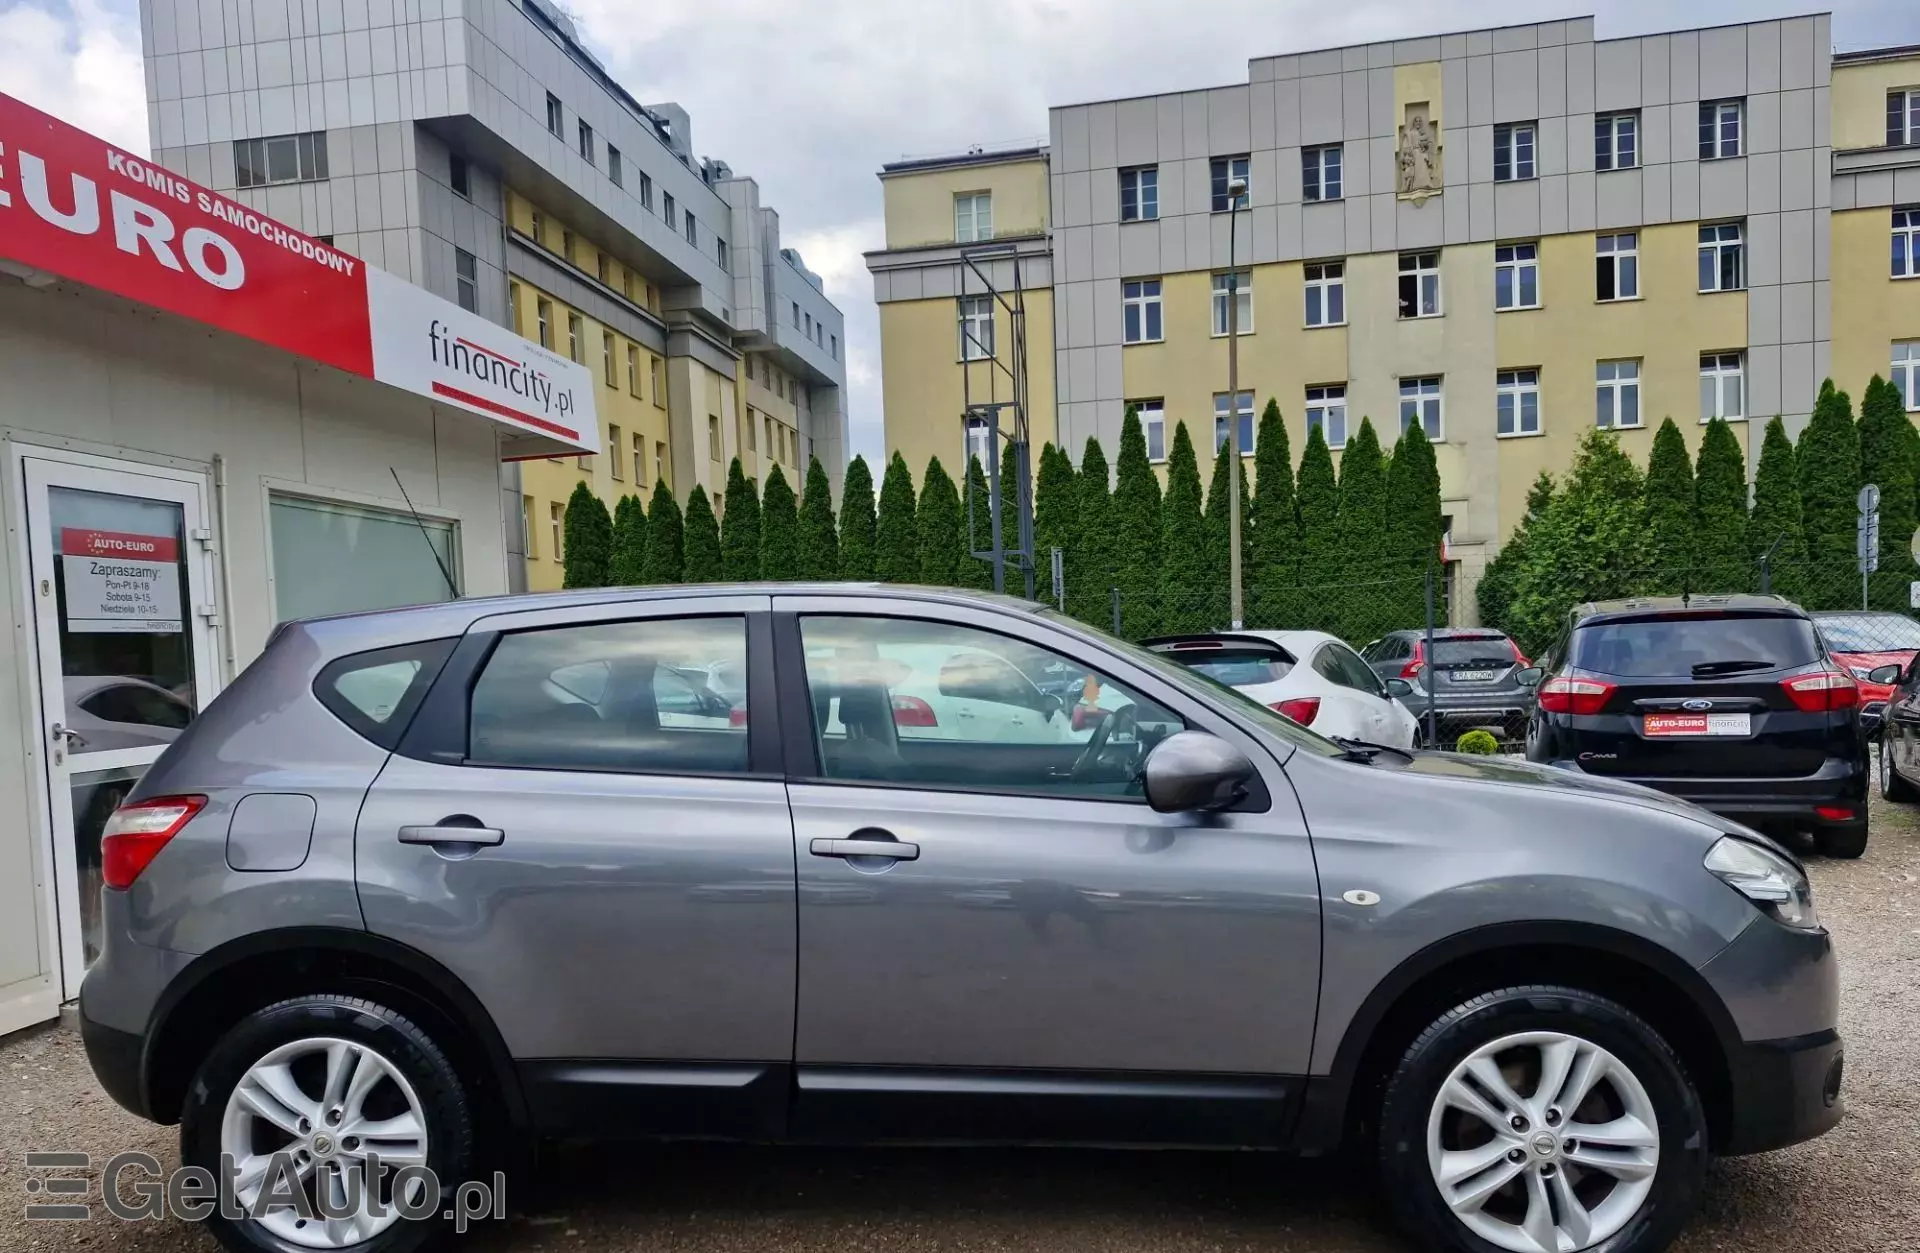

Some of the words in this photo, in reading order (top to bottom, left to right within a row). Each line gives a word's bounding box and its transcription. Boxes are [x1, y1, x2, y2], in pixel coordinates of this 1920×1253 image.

[0, 140, 246, 290] URO
[106, 149, 191, 204] KOMIS
[197, 192, 356, 277] SAMOCHODOWY
[428, 319, 575, 418] financity.pl
[94, 539, 154, 552] AUTO-EURO
[90, 562, 161, 581] Zapraszamy:
[106, 591, 132, 602] Sobota
[133, 592, 151, 603] 9-15
[100, 603, 135, 614] Niedziela
[136, 604, 158, 615] 10-15
[1650, 719, 1705, 728] AUTO-EURO
